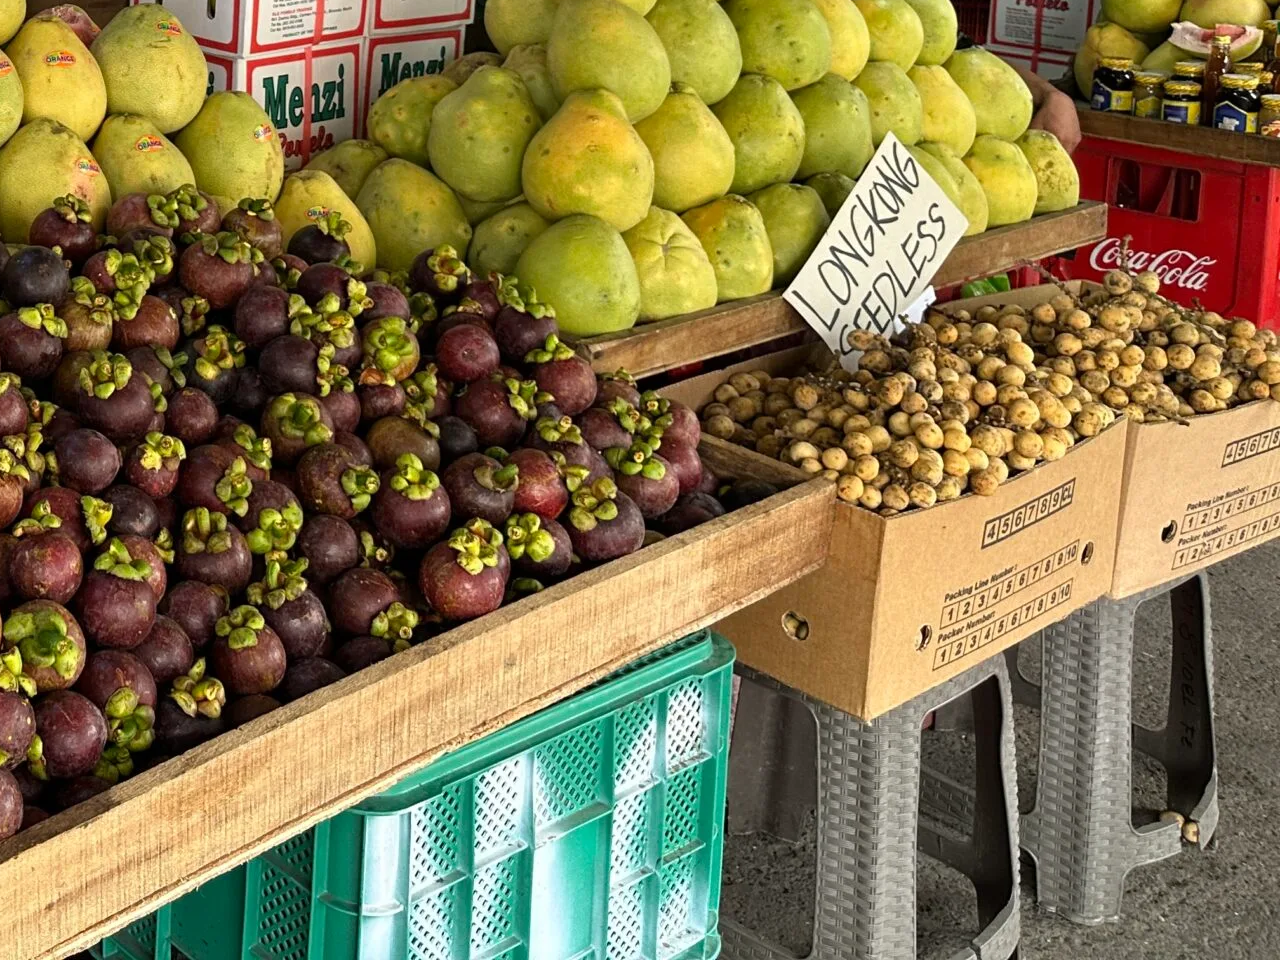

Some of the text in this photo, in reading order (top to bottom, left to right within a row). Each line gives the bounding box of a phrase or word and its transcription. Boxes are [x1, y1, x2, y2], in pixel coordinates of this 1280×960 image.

[157, 23, 181, 34] ORANGE
[45, 55, 75, 64] ORANGE
[262, 63, 346, 130] Menzi
[138, 140, 163, 151] ORANGE
[792, 141, 920, 332] LONGKONG
[1089, 235, 1219, 293] Coca-Cola
[1226, 431, 1280, 459] 4 5 6 7 8
[986, 484, 1073, 541] 4 5 6 7 8 9 CL
[1186, 498, 1211, 511] Packing
[1212, 494, 1224, 504] Line
[1178, 534, 1201, 547] Packer
[944, 563, 1018, 604] Packing Line Number:
[937, 611, 996, 643] Packer Number:
